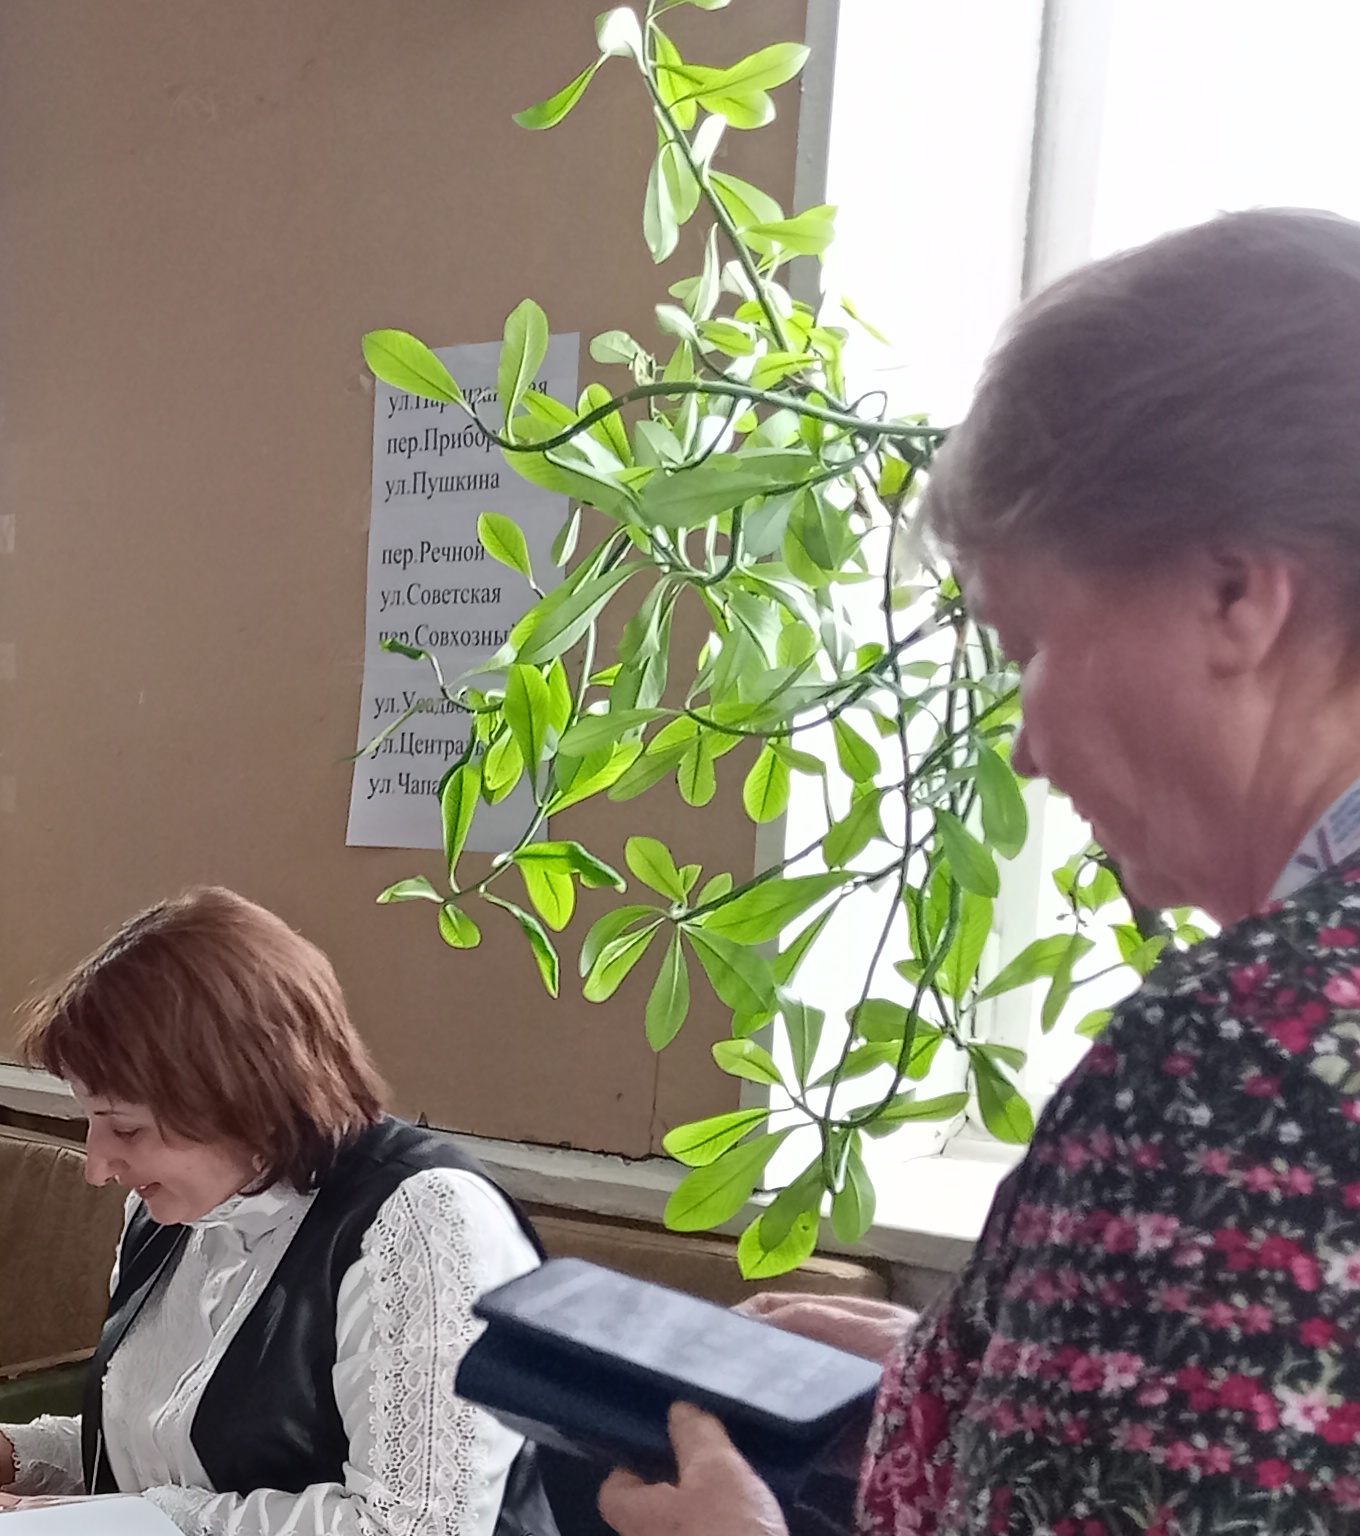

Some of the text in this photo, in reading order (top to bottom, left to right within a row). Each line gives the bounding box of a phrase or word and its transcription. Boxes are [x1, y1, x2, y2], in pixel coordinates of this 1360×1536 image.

[387, 424, 497, 459] пер.Прибор
[385, 472, 500, 502] ул.Пушкина
[382, 541, 485, 570] пер.Речной
[380, 583, 501, 612] ул.Советская
[379, 624, 515, 647] пер.Совхозны
[367, 772, 439, 800] ул.Чапа
